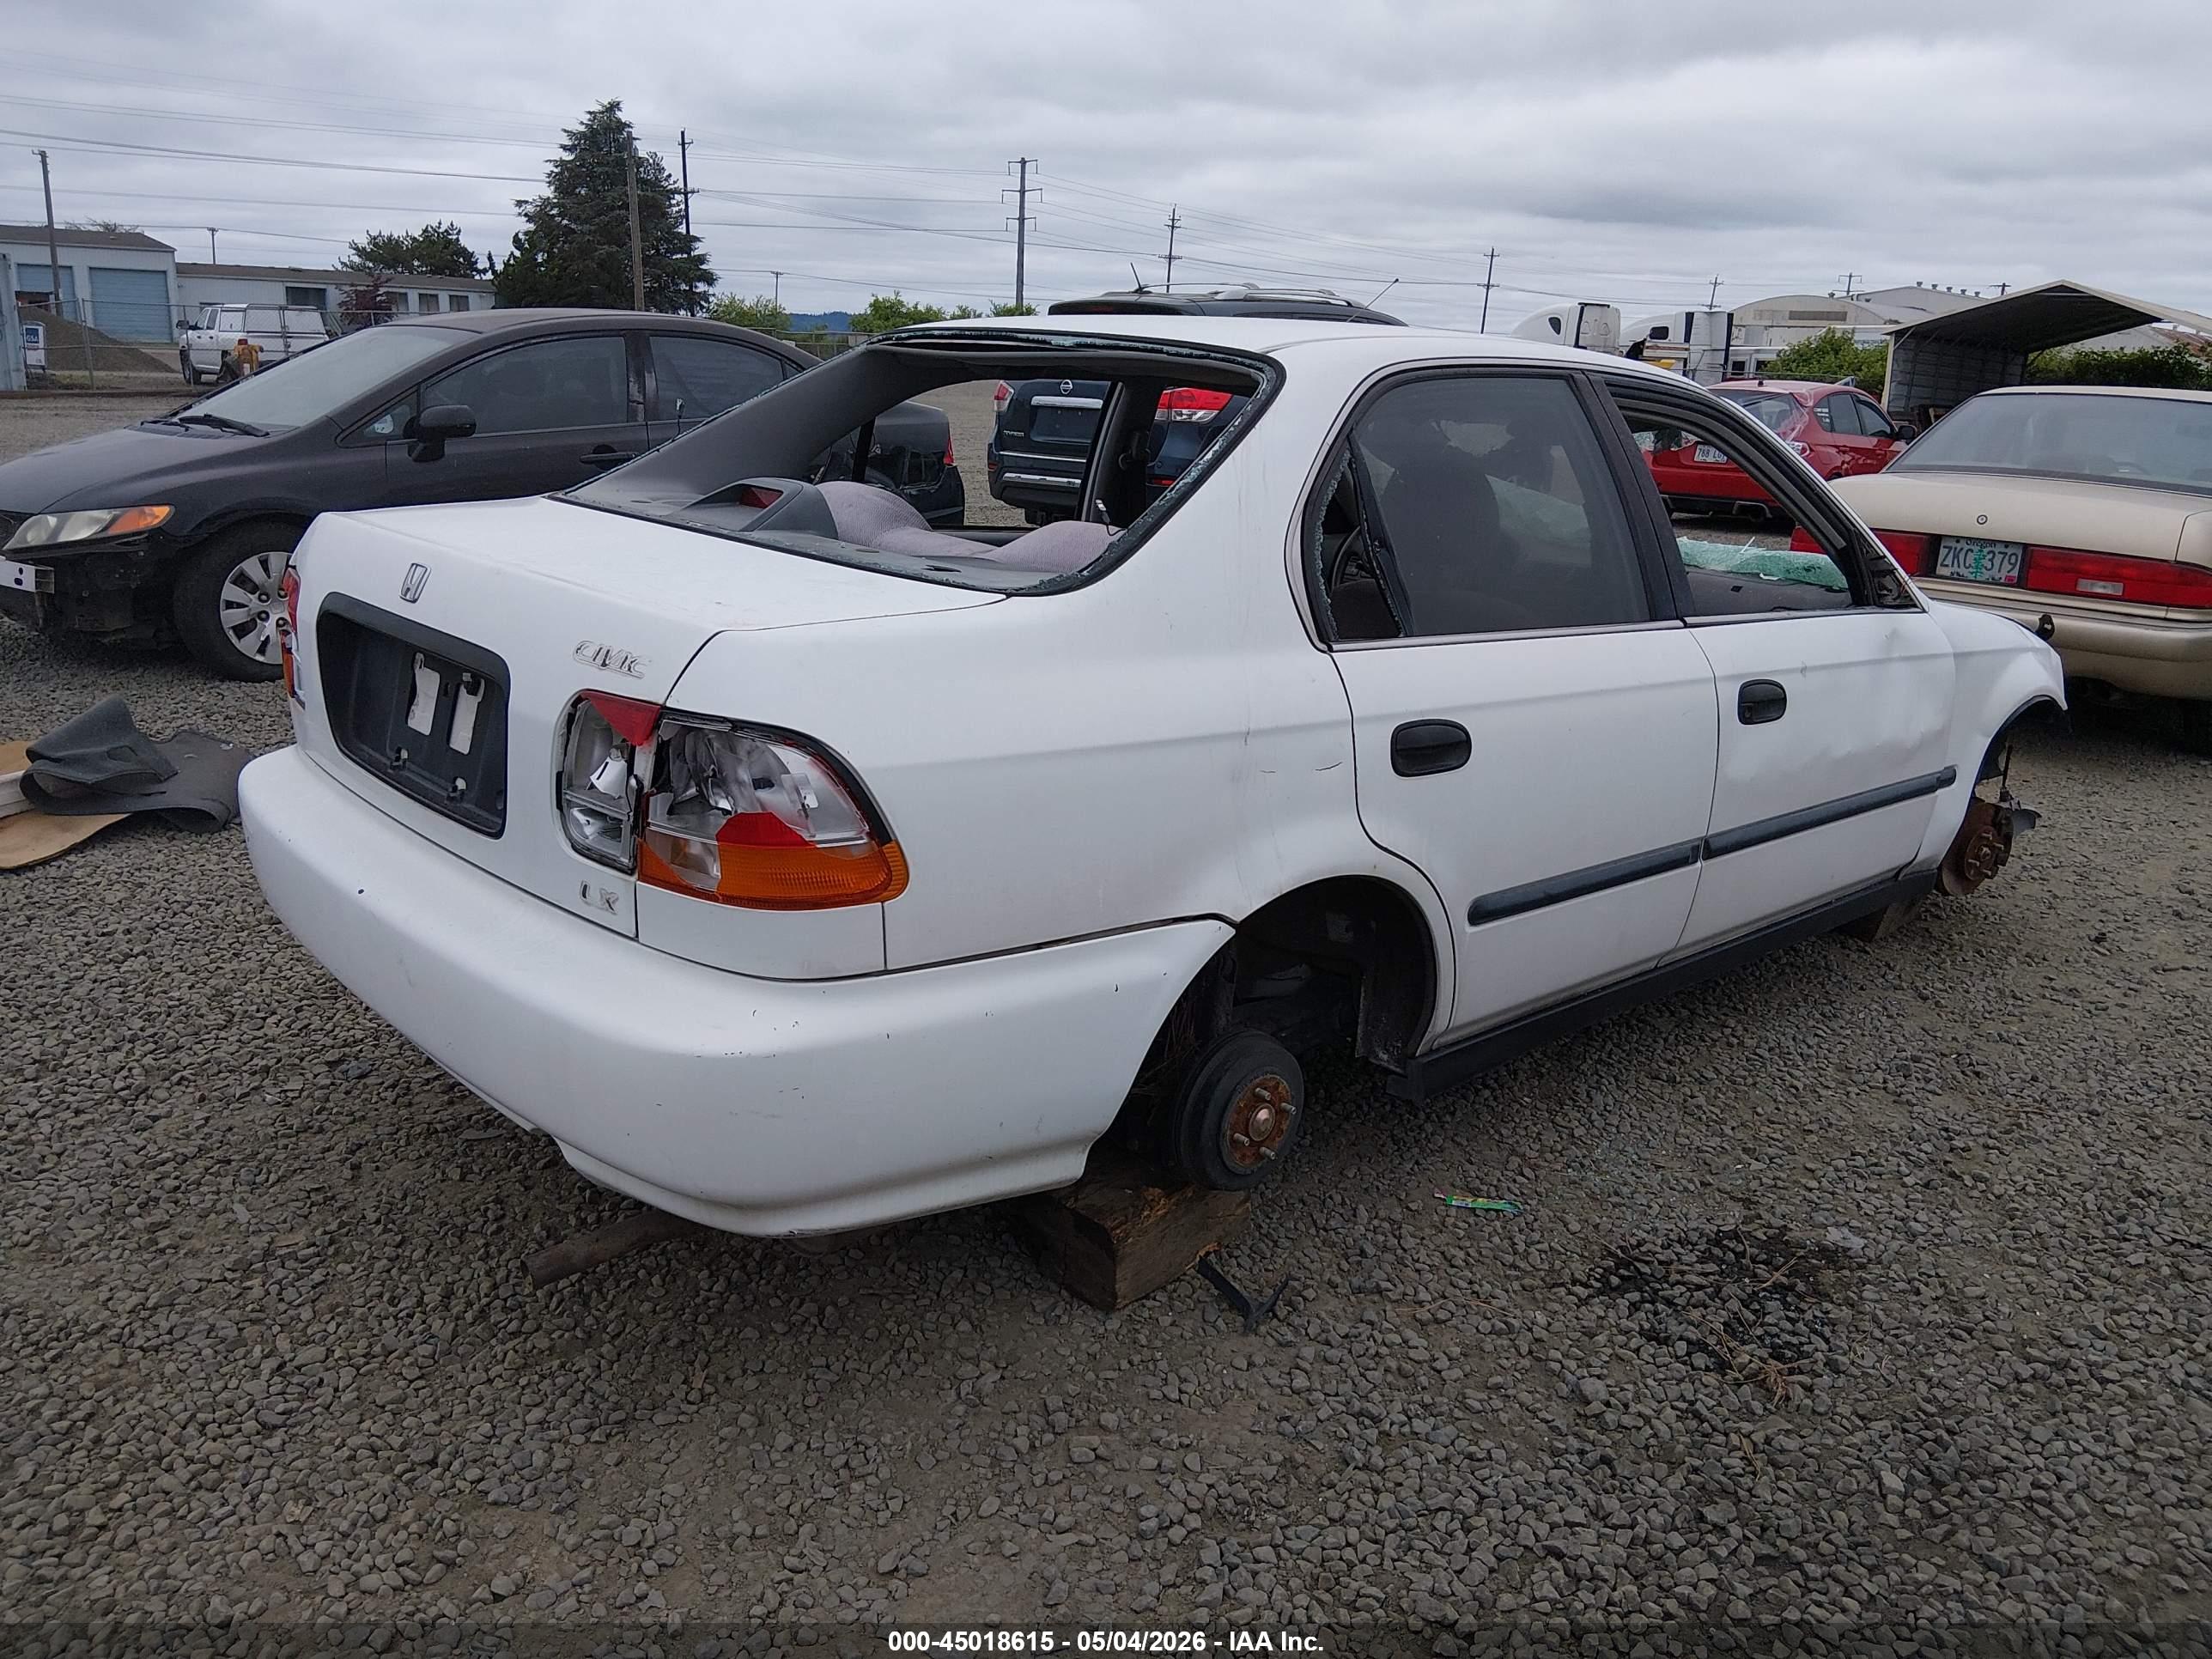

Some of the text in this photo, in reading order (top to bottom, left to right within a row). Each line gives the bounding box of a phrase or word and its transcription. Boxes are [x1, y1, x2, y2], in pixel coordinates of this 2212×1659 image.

[1940, 545, 2019, 574] ZKC 379
[1966, 539, 1996, 549] Oregon
[574, 641, 646, 679] CIVIC
[580, 880, 619, 915] LX
